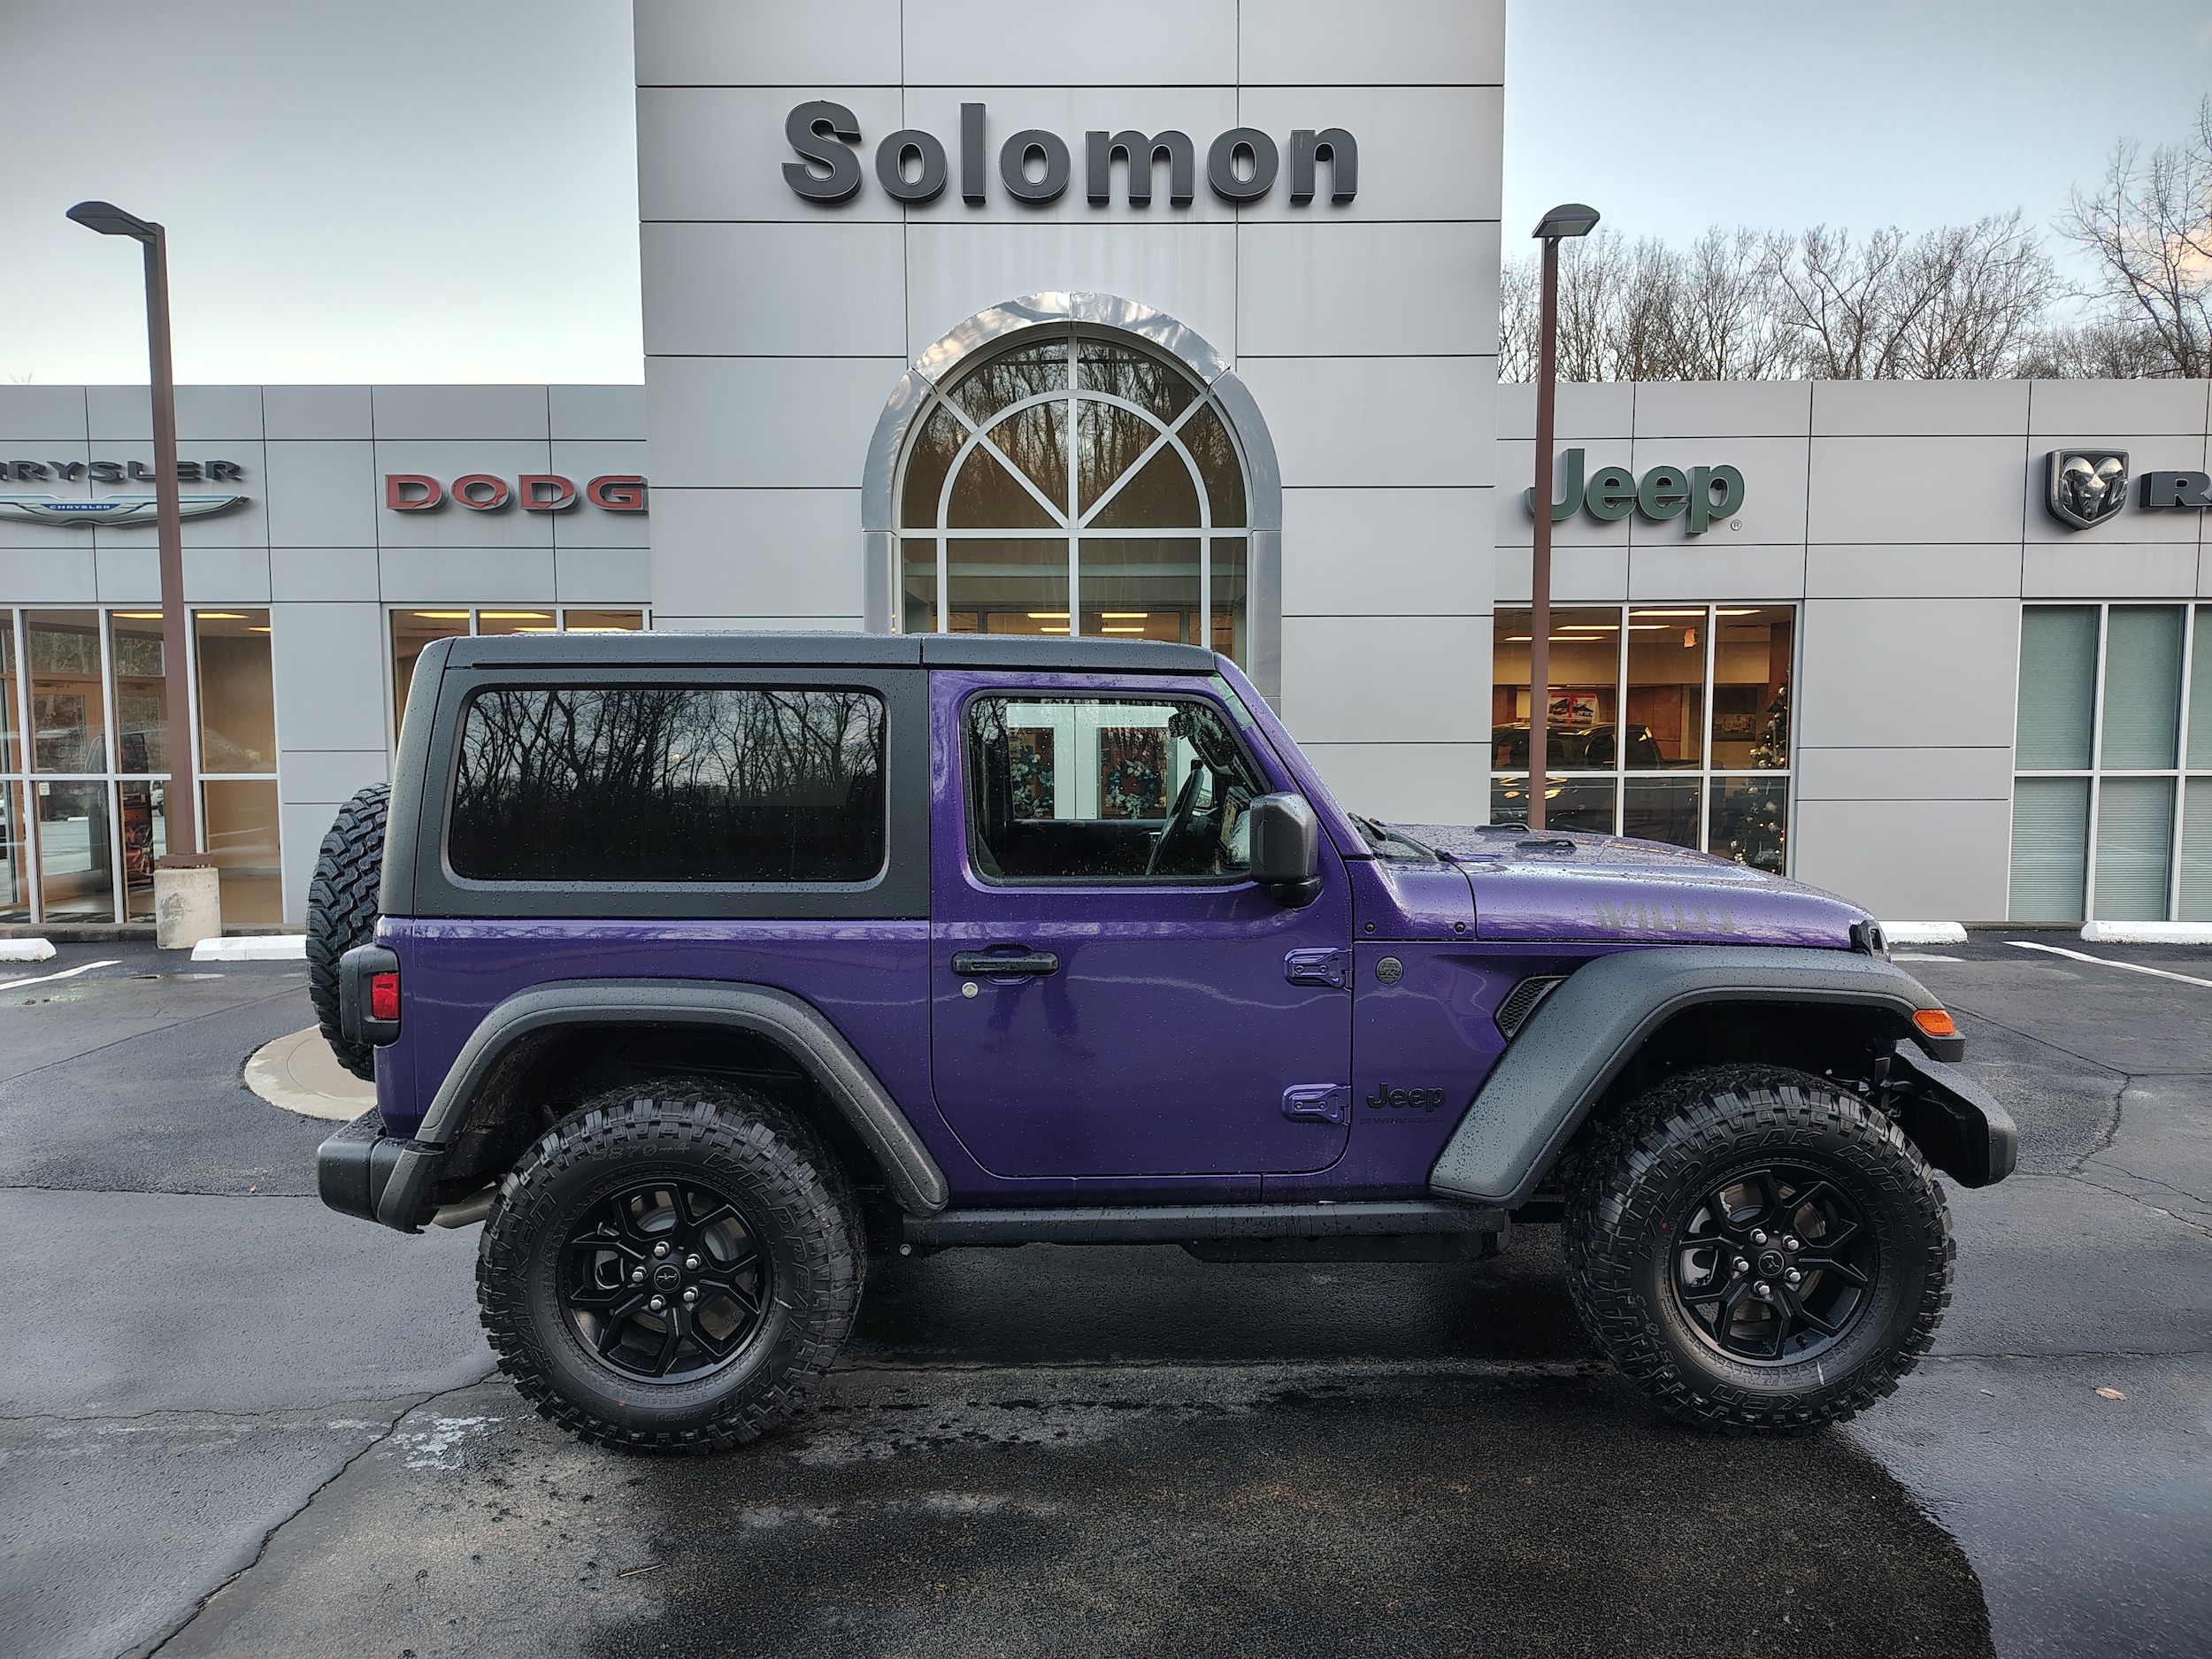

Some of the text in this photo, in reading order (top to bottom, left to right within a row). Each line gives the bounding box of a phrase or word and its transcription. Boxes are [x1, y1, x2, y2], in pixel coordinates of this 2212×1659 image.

[781, 100, 1359, 205] Solomon
[0, 460, 242, 480] RYSLER
[385, 473, 649, 514] DODG
[1525, 448, 1746, 534] Jeep
[1592, 900, 1735, 933] WILLYS
[1366, 1081, 1446, 1112] Jeep
